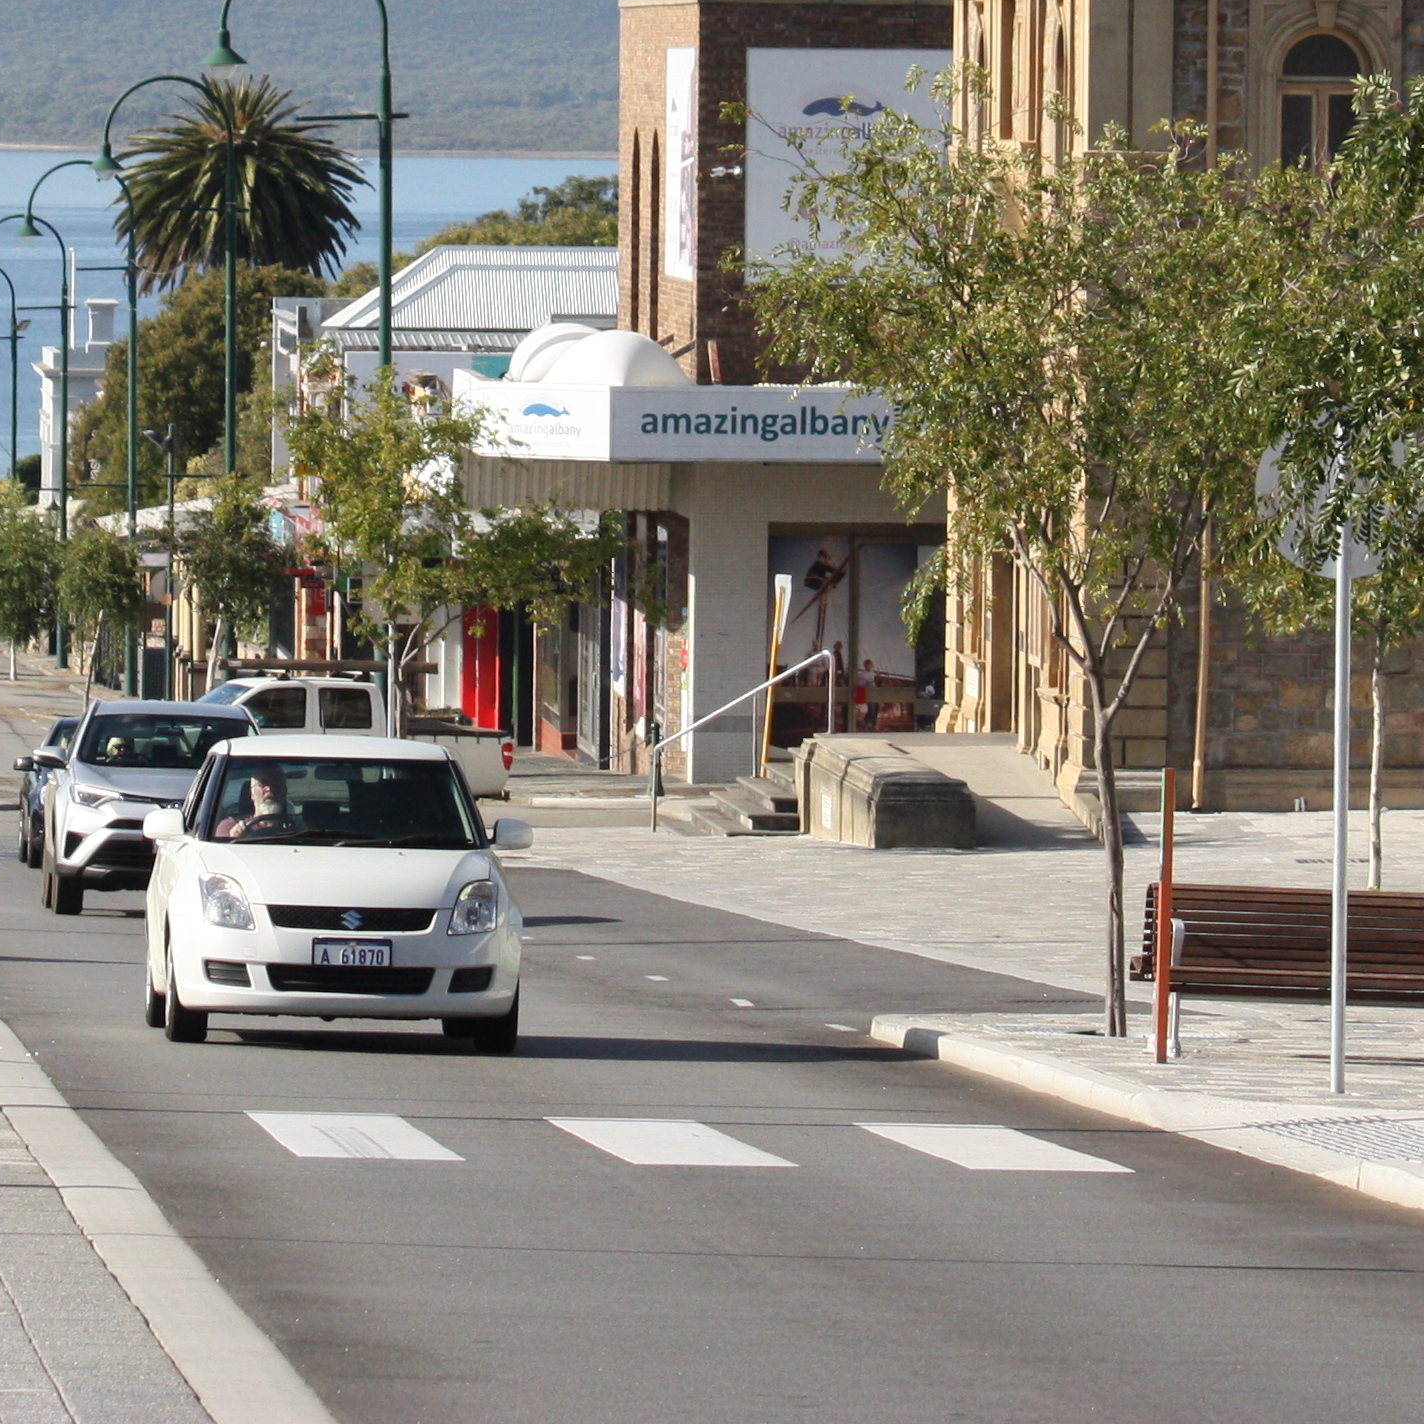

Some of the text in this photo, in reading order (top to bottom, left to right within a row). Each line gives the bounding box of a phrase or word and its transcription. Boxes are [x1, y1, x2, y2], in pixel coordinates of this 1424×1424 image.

[507, 422, 582, 438] amazingalbany
[640, 406, 890, 442] amazingalbany
[321, 948, 384, 965] A 61870
